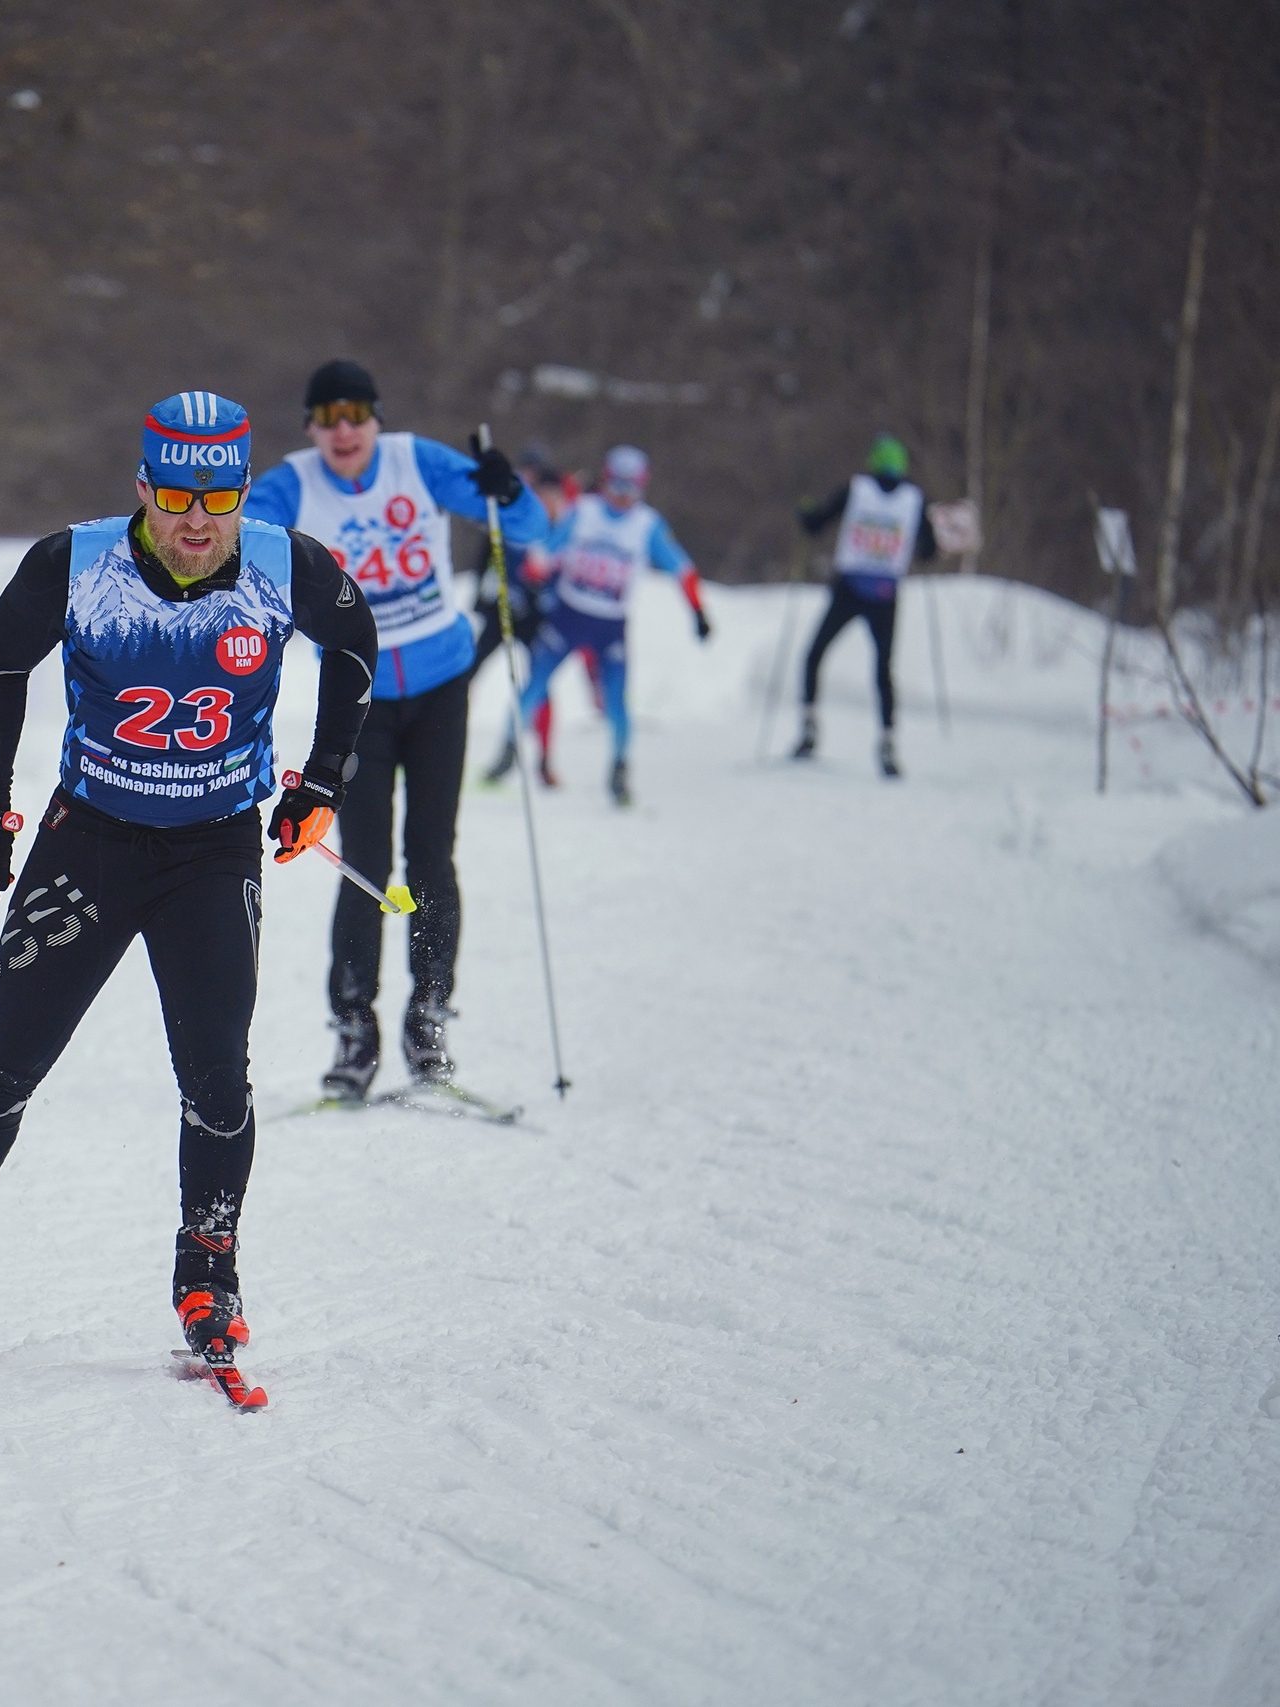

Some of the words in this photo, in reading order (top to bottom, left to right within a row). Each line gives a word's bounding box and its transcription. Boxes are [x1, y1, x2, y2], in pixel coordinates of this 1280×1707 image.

[160, 443, 241, 467] LUKOIL
[224, 636, 261, 658] 100
[113, 686, 234, 751] 23
[79, 755, 205, 798] Сверхмарафон
[304, 780, 334, 798] ROSSIGNOL
